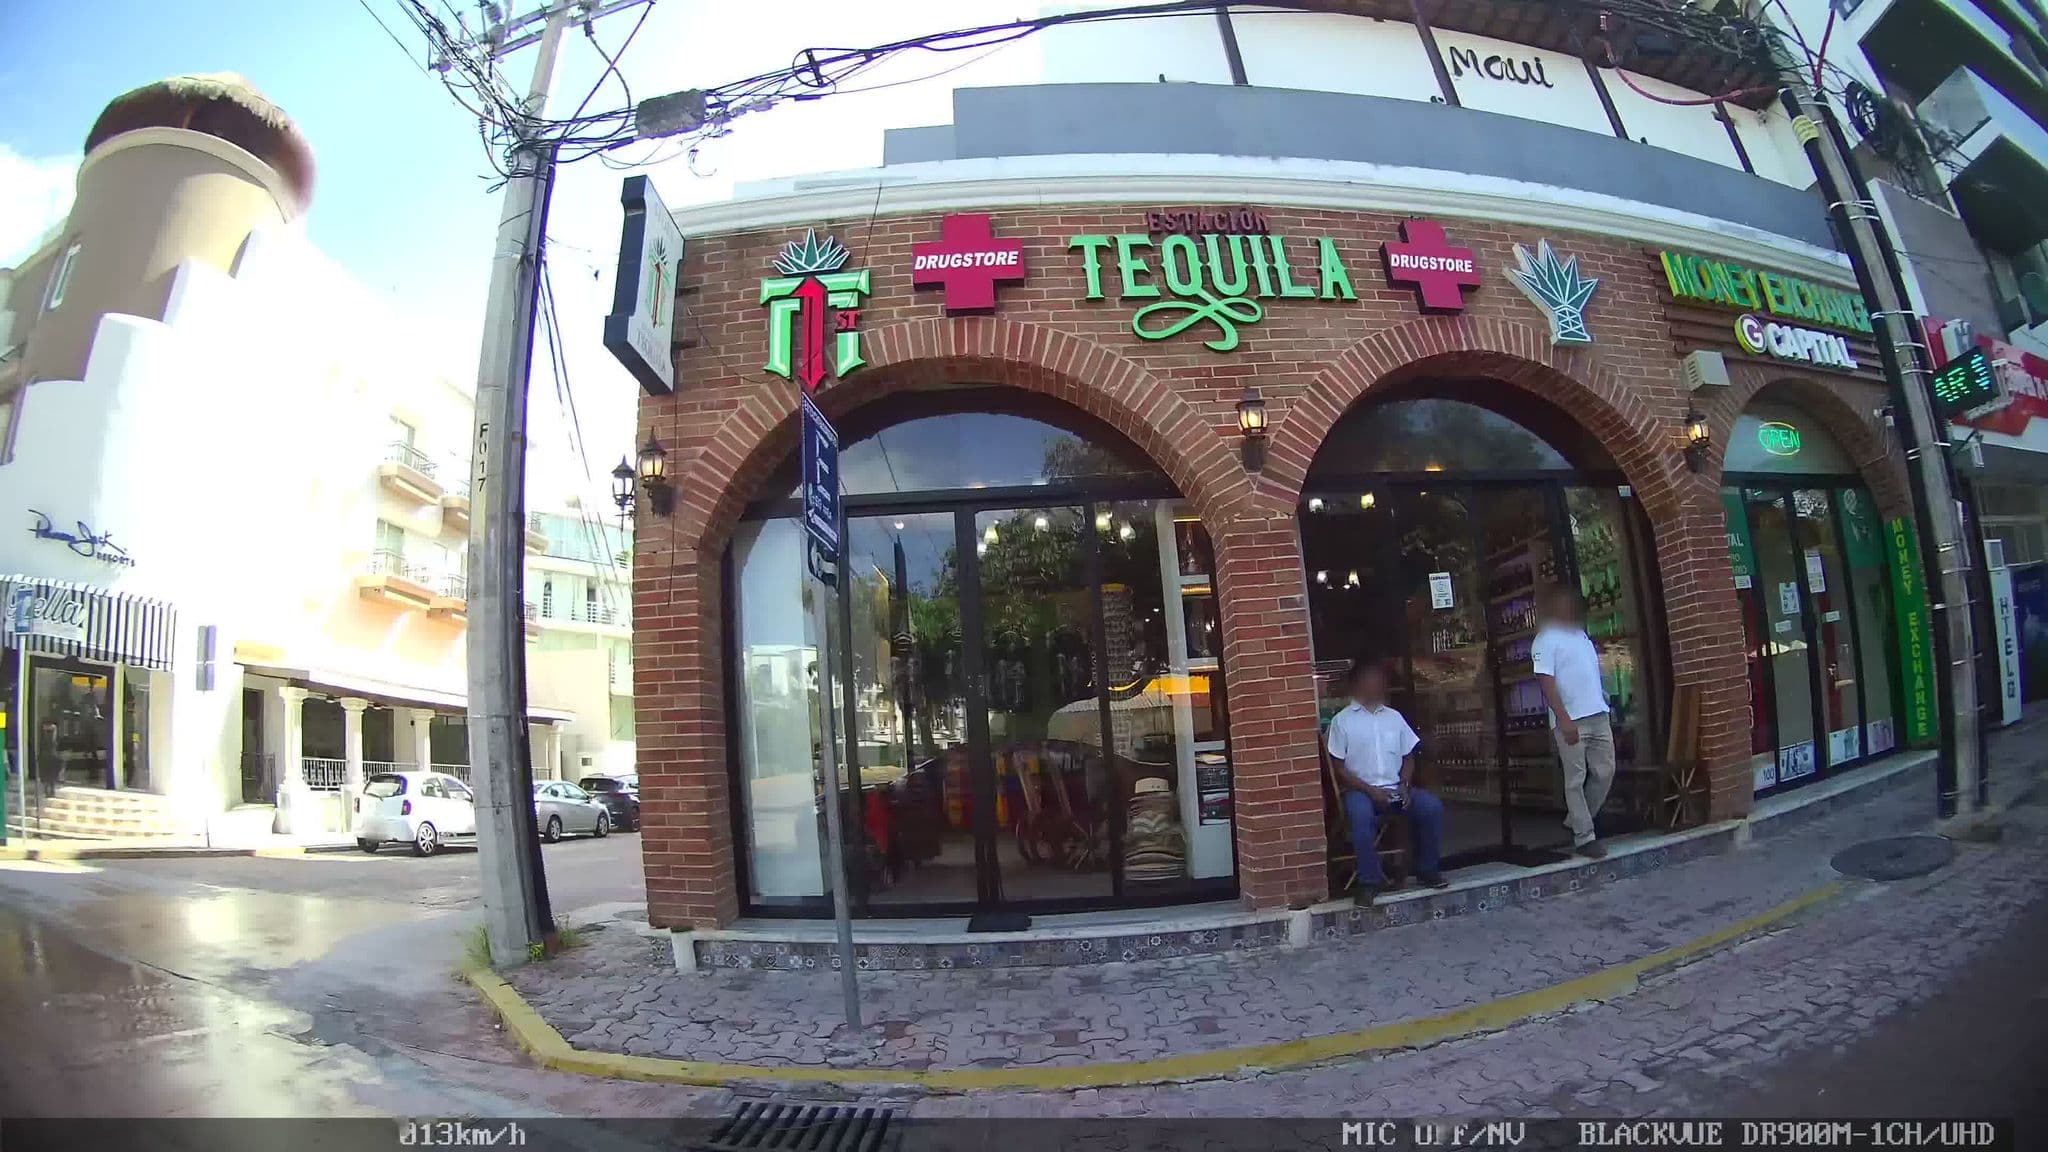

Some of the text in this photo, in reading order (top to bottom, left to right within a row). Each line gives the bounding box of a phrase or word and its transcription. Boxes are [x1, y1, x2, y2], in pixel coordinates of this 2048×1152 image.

[1449, 46, 1554, 88] Maui
[914, 250, 1019, 270] DRUGSTORE
[1390, 254, 1473, 273] DRUGSTORE
[1659, 251, 1762, 312] MONEY
[1068, 234, 1358, 351] TEQUILA
[1764, 322, 1858, 369] CAPITAL
[1759, 429, 1801, 449] OPEN
[1891, 518, 1928, 737] MONEY EXCHANGE
